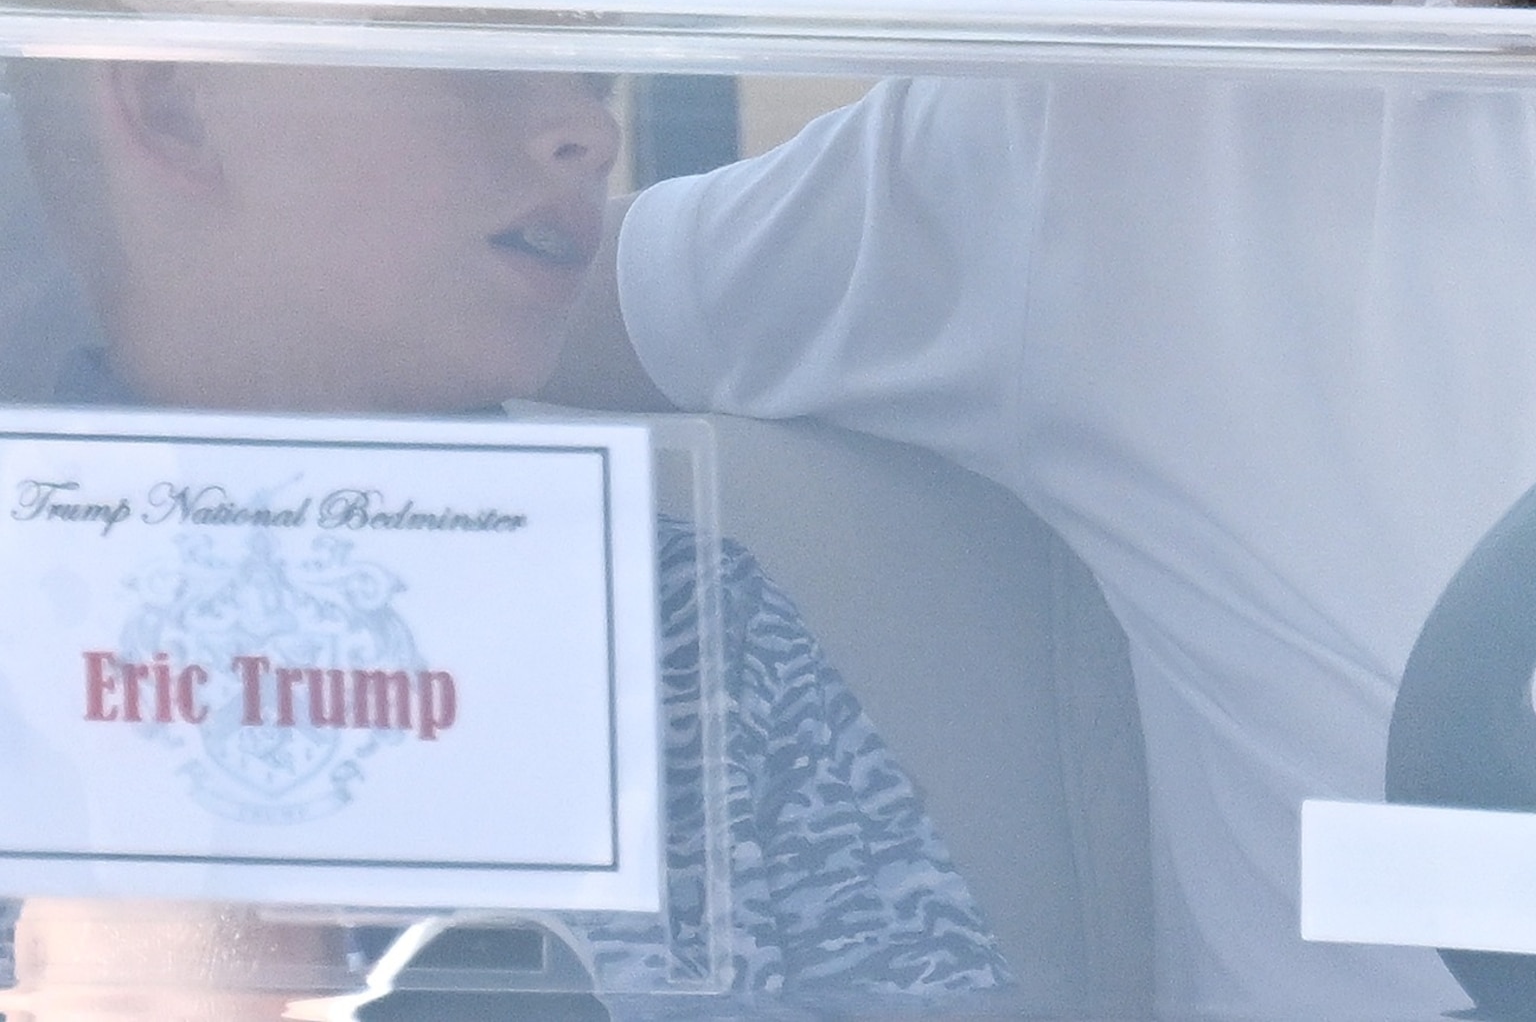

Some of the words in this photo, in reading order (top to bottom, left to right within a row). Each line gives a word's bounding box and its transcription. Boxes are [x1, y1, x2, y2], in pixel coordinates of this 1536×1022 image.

[11, 480, 131, 537] Trump
[141, 482, 312, 527] National
[316, 488, 527, 531] Bedminster
[83, 651, 209, 725] Eric
[231, 655, 458, 741] Trump
